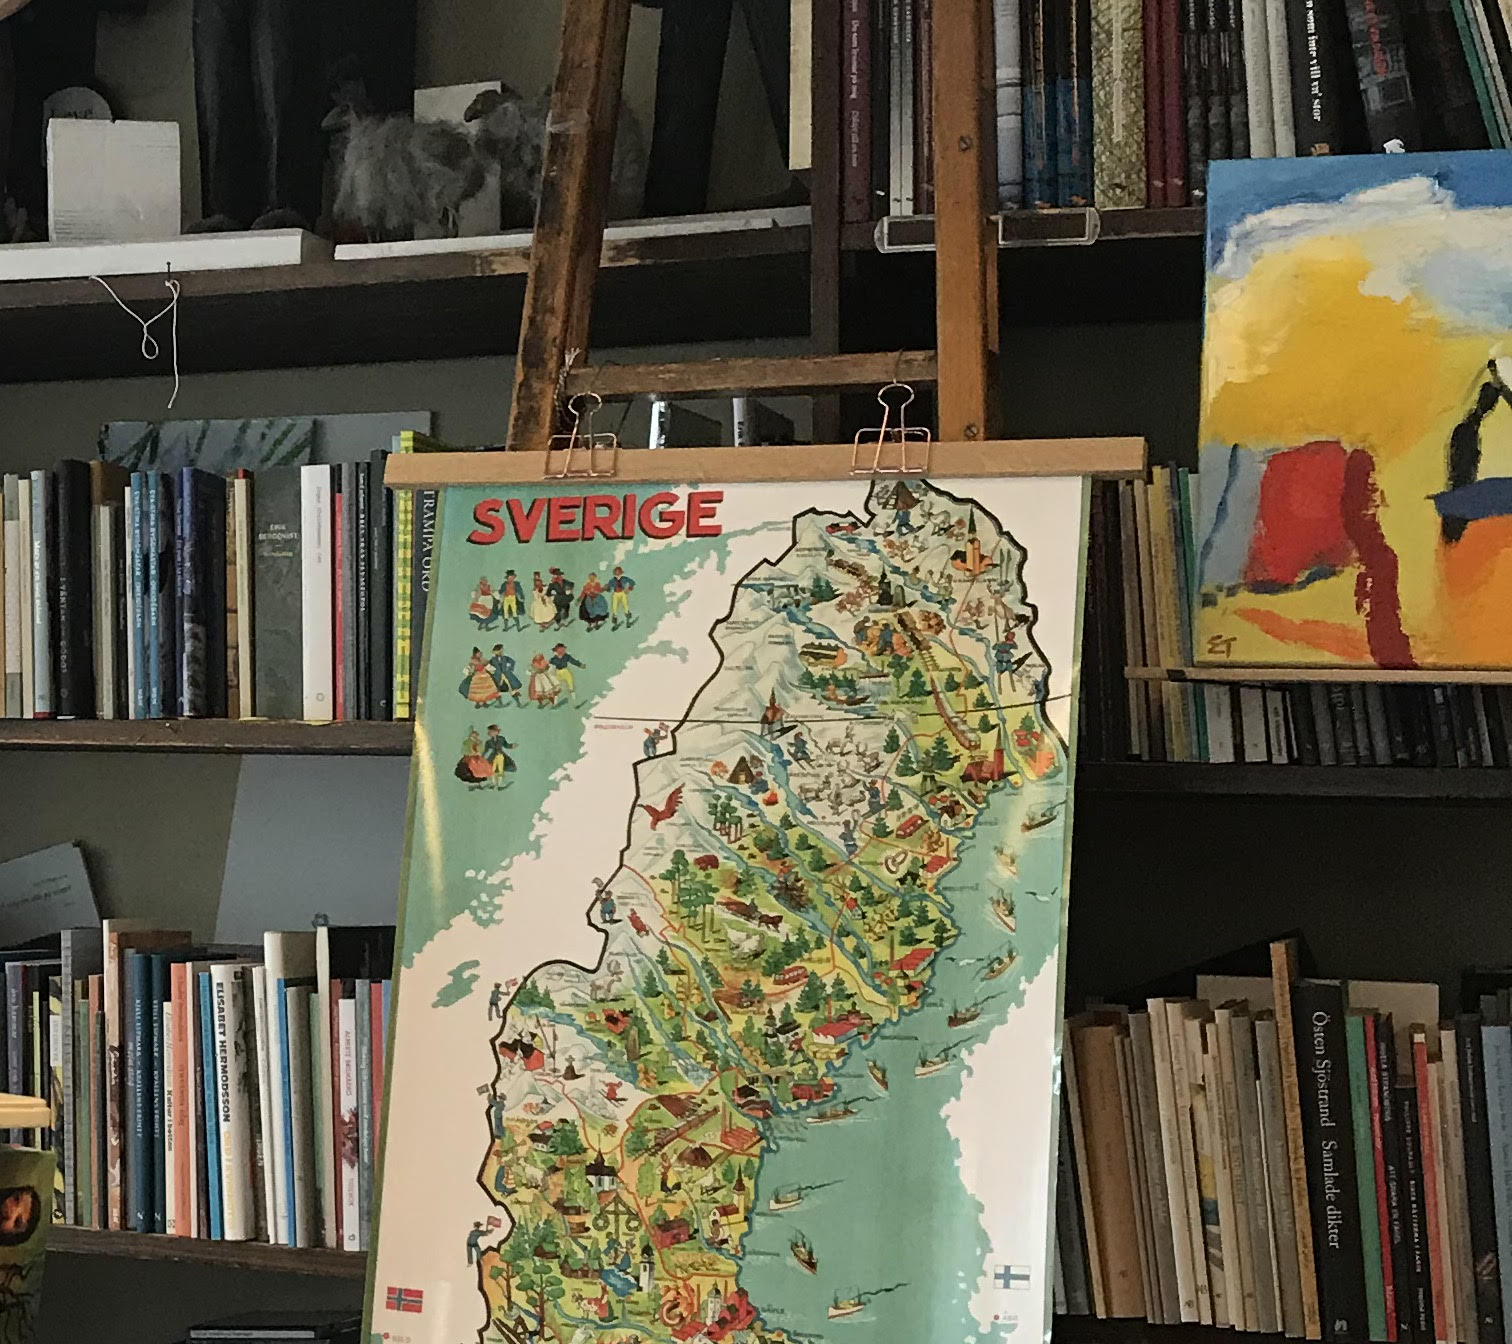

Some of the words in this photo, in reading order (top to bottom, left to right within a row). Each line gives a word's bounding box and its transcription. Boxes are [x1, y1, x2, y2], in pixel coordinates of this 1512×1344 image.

[1306, 9, 1316, 33] som
[467, 489, 724, 547] SVERIGE
[215, 982, 227, 1036] ELISABET
[1311, 1011, 1331, 1056] Östen
[218, 1039, 231, 1122] HERMODSSON
[1315, 1058, 1337, 1128] Sjöstrand
[1320, 1139, 1341, 1202] Samlade
[1326, 1205, 1344, 1249] dikter
